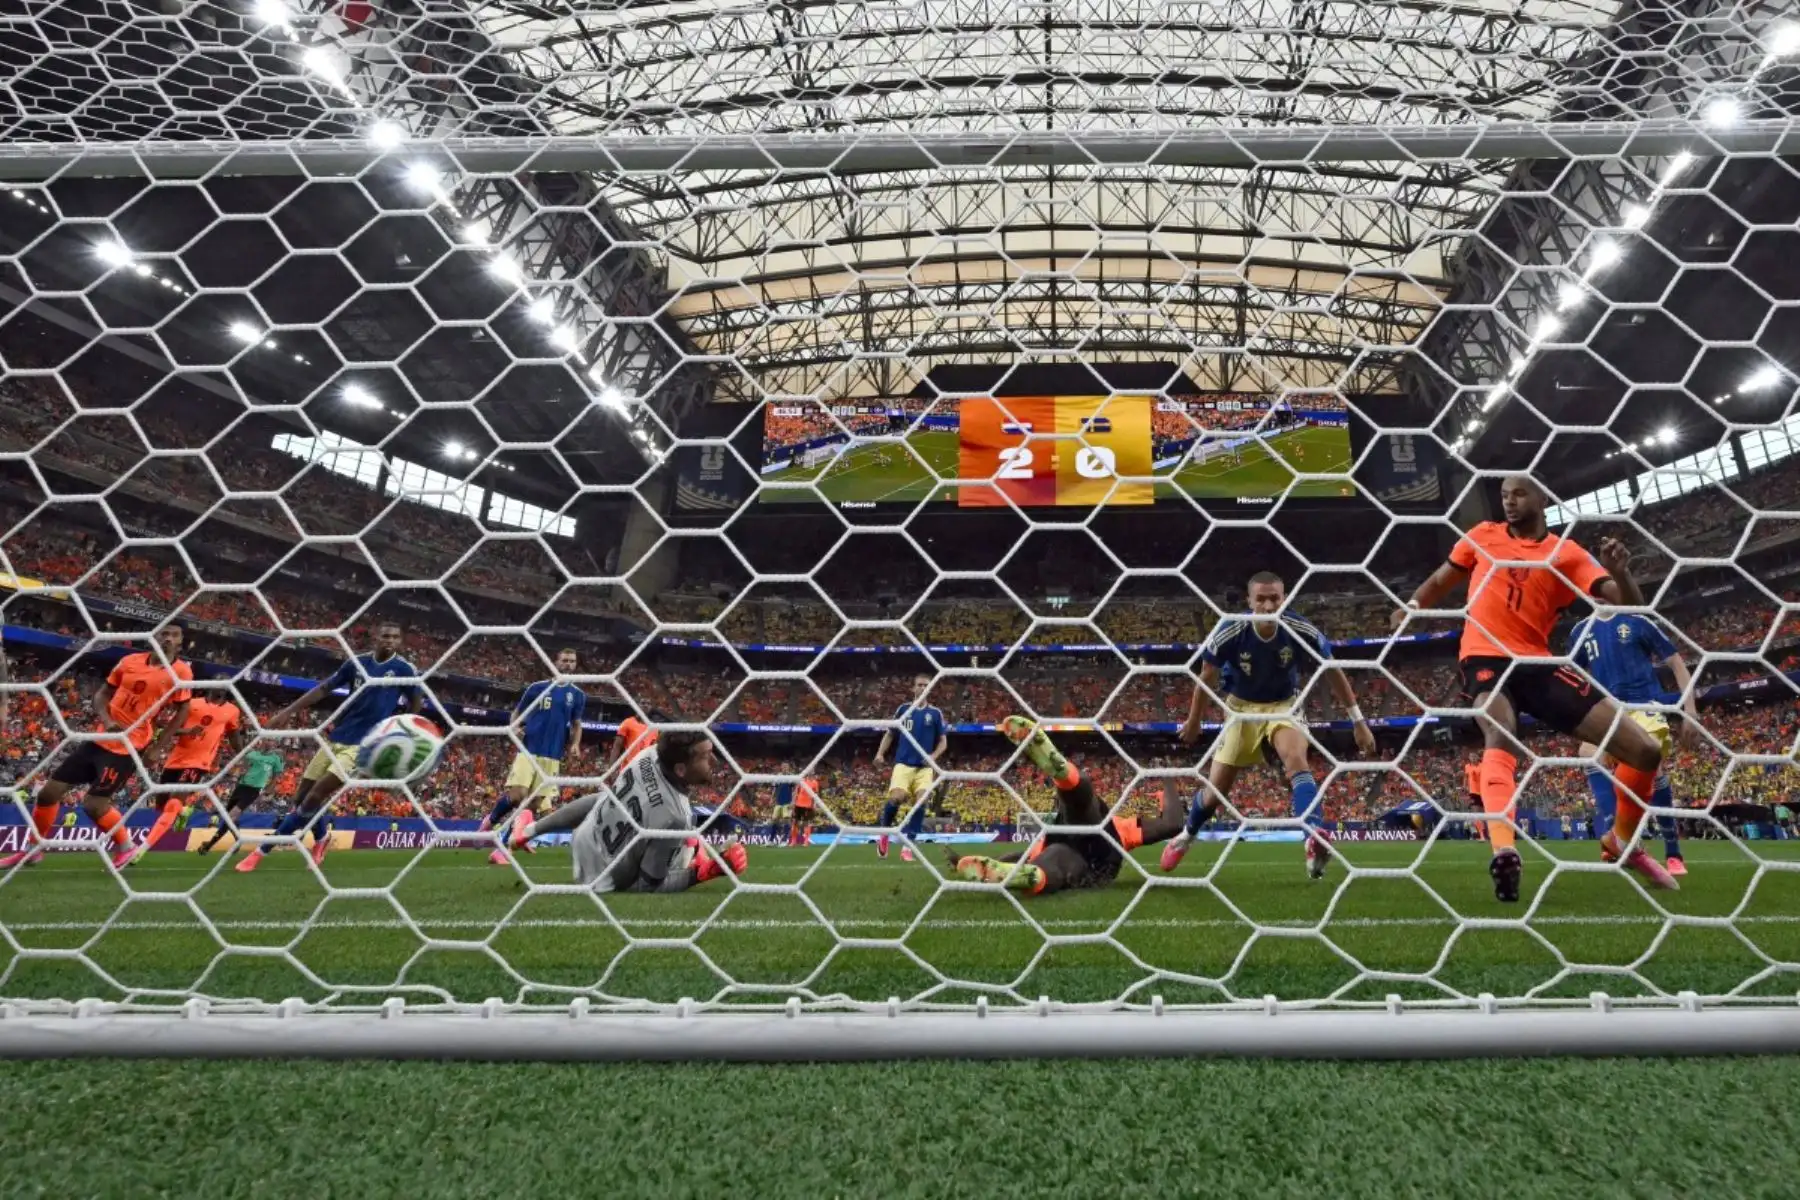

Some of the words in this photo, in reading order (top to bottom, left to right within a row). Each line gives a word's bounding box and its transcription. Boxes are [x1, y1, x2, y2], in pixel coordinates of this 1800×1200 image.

[998, 447, 1034, 479] 2
[1075, 446, 1116, 478] 0
[1236, 497, 1273, 505] Hisense
[1506, 583, 1523, 613] 11
[1585, 639, 1599, 662] 21
[100, 766, 118, 785] 14
[376, 831, 416, 850] QATAR
[1328, 830, 1359, 841] ATAR
[1364, 829, 1417, 841] AIRWAYS
